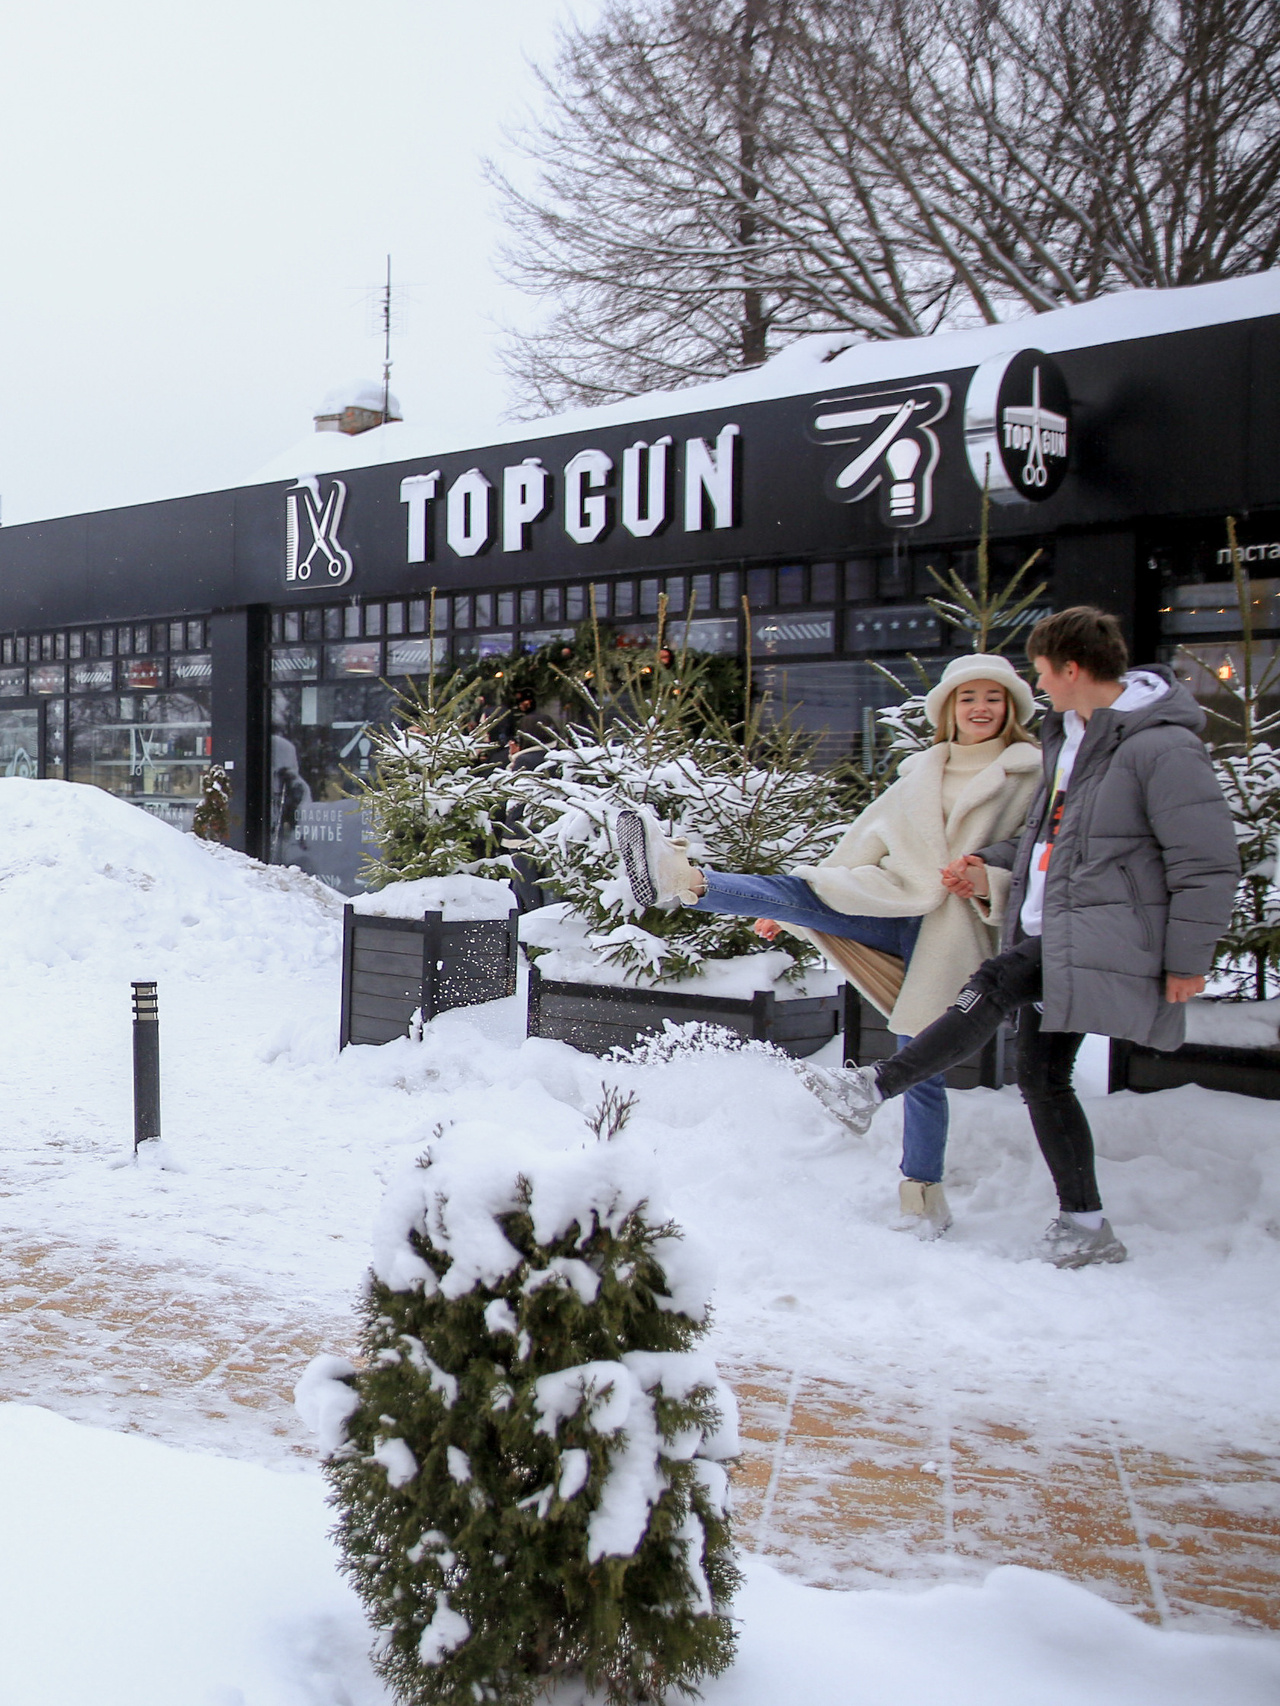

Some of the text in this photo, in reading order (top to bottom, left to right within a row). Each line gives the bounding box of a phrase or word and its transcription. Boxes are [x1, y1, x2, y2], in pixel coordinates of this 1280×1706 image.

[1003, 423, 1066, 457] TOP GUN
[294, 809, 343, 822] ОПАСНОЕ
[294, 823, 343, 842] БРИТЬЁ
